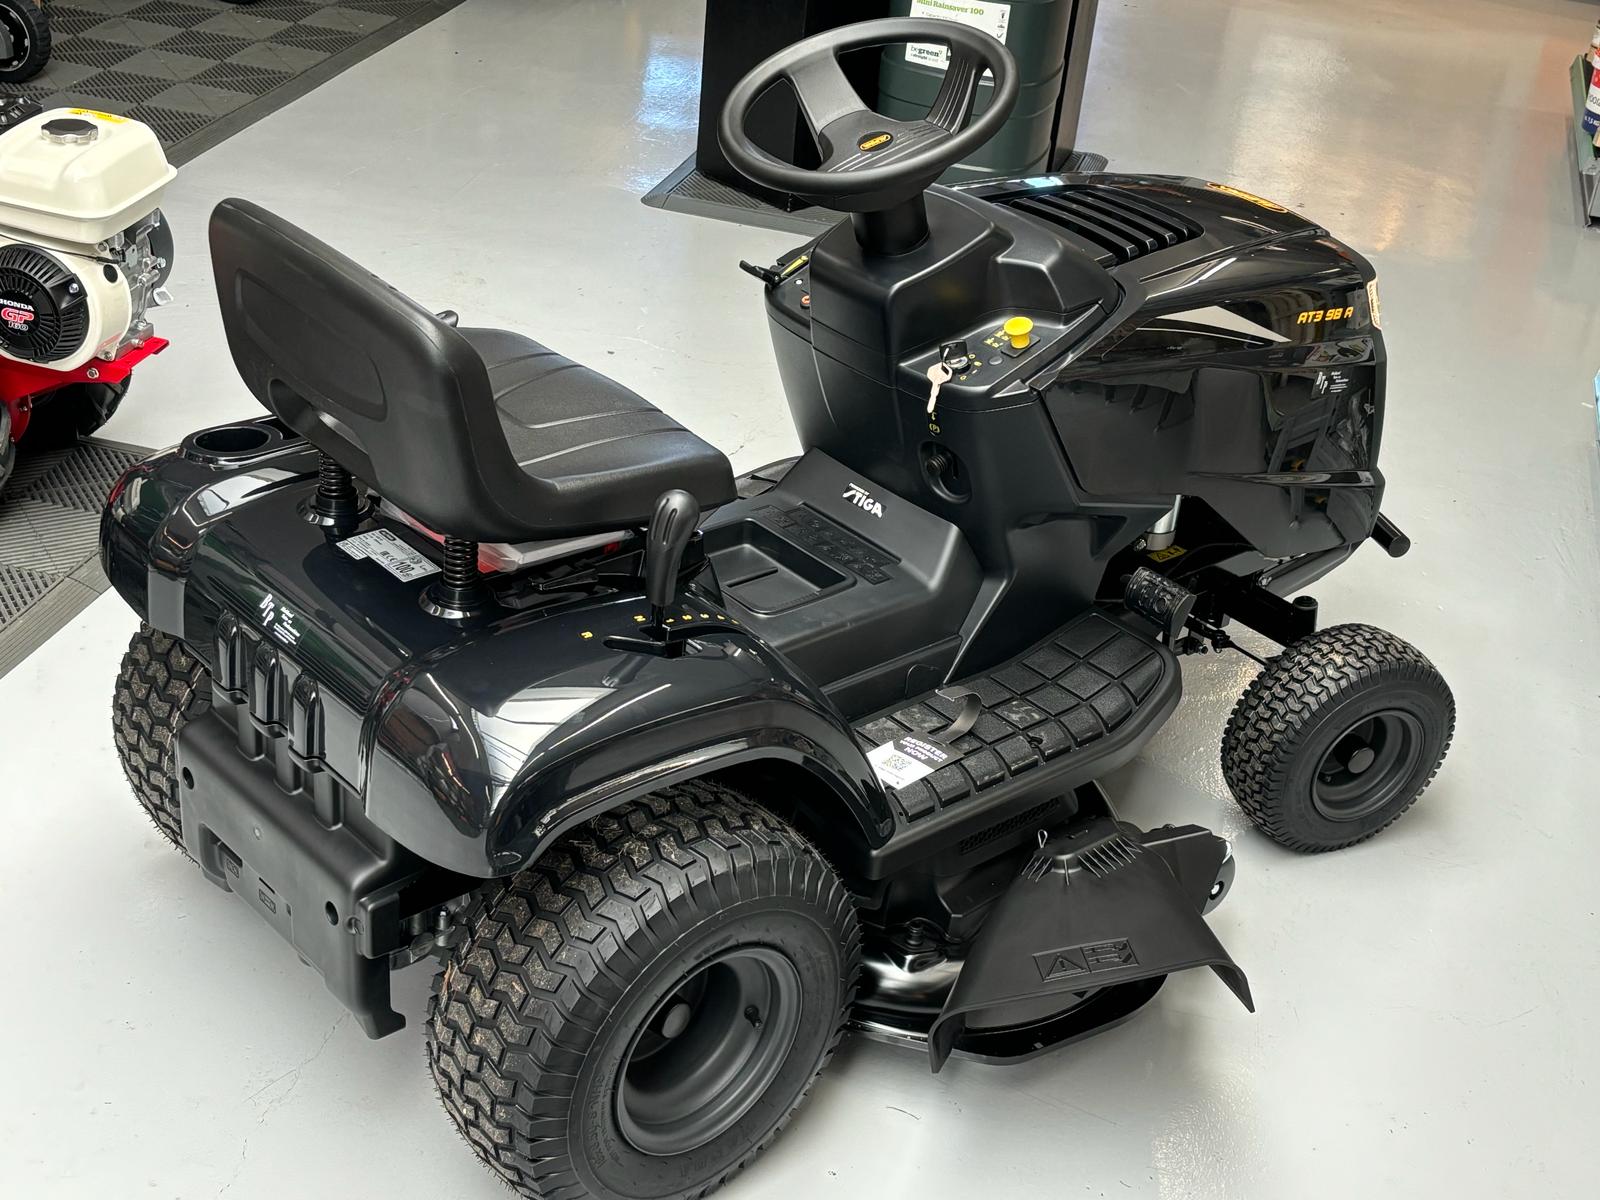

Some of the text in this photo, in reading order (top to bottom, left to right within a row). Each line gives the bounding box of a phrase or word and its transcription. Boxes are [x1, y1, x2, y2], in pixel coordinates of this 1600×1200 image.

[933, 0, 968, 13] Rainsaver
[0, 299, 34, 311] HONDA
[1, 308, 34, 324] GP
[1297, 310, 1324, 324] AT3
[1344, 306, 1354, 319] A
[842, 483, 882, 518] STIGA
[904, 736, 948, 760] REGISTER
[904, 746, 928, 760] NOW
